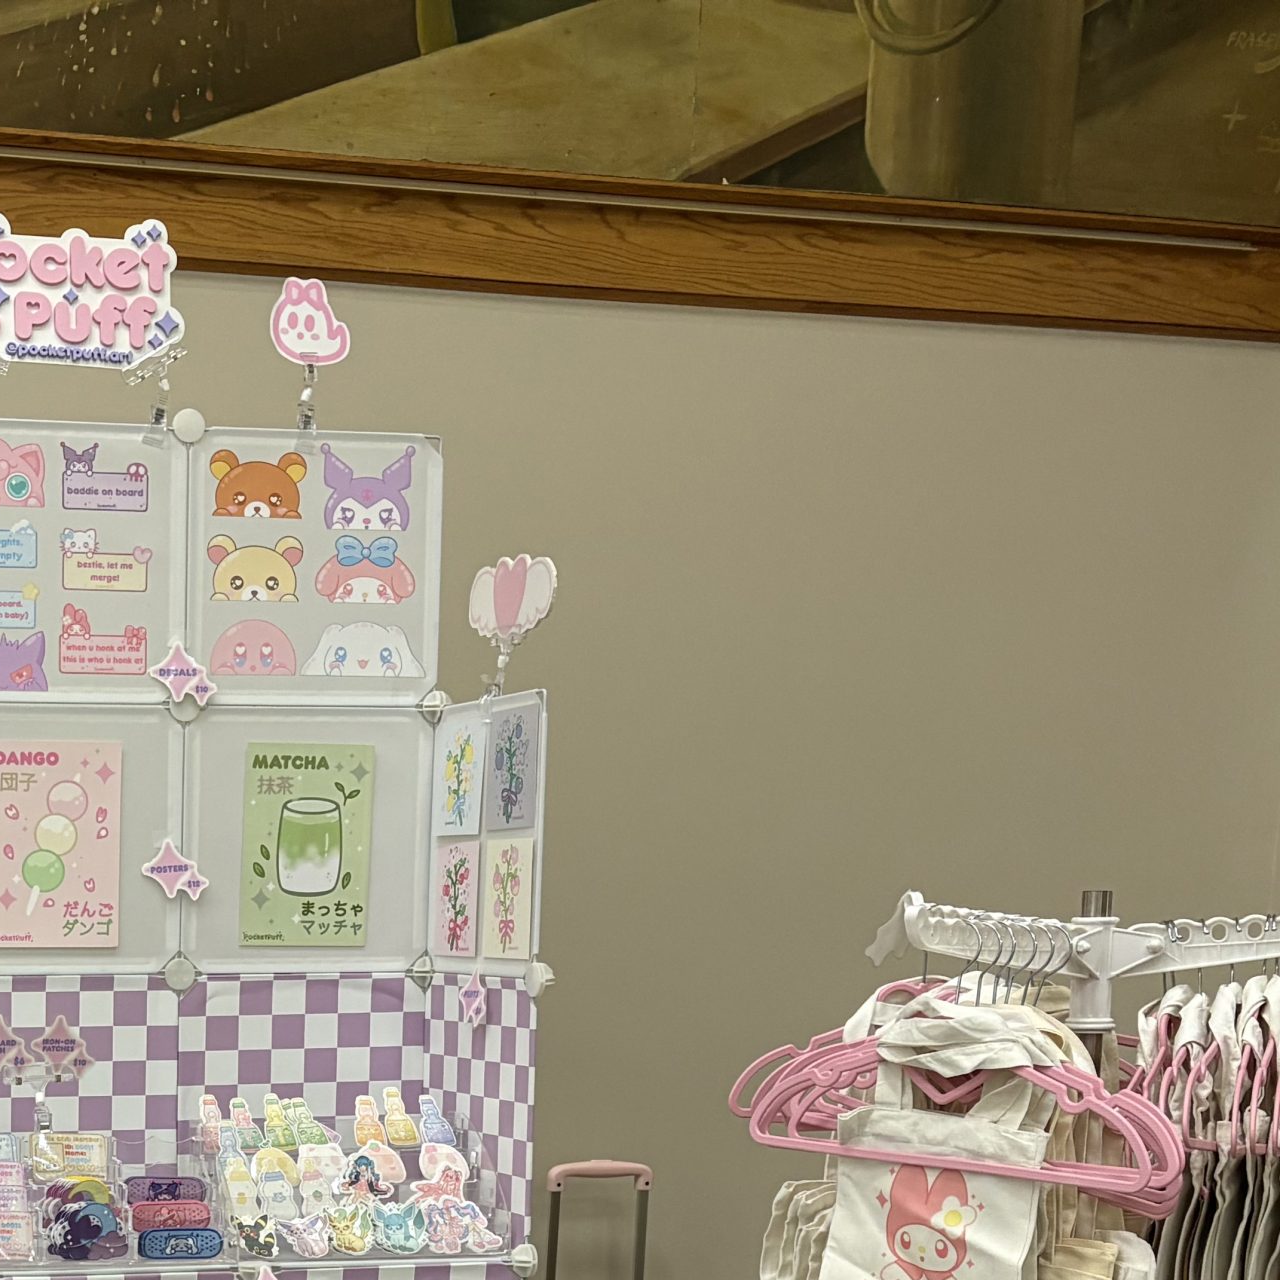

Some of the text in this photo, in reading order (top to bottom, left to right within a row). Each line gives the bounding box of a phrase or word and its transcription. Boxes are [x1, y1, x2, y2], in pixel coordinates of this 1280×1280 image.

[14, 291, 159, 349] Puff
[5, 341, 134, 366] @pocketpuff.art
[66, 487, 144, 497] baddie on board
[107, 561, 118, 570] let
[120, 562, 134, 570] me
[90, 574, 119, 584] merge!
[5, 611, 29, 621] baby)
[66, 644, 86, 653] when
[95, 644, 114, 653] honk
[117, 645, 126, 653] at
[63, 656, 77, 665] this
[87, 656, 104, 665] who
[113, 656, 132, 665] honk
[134, 656, 143, 666] at
[252, 754, 330, 770] MATCHA
[0, 772, 37, 792] 団子
[257, 774, 294, 795] 抹茶
[150, 864, 189, 875] POSTERS
[63, 900, 114, 918] だんご
[301, 900, 364, 917] まっちゃ
[62, 918, 113, 937] ダンゴ
[300, 919, 363, 937] マッチャ
[42, 1045, 74, 1053] PATCHES
